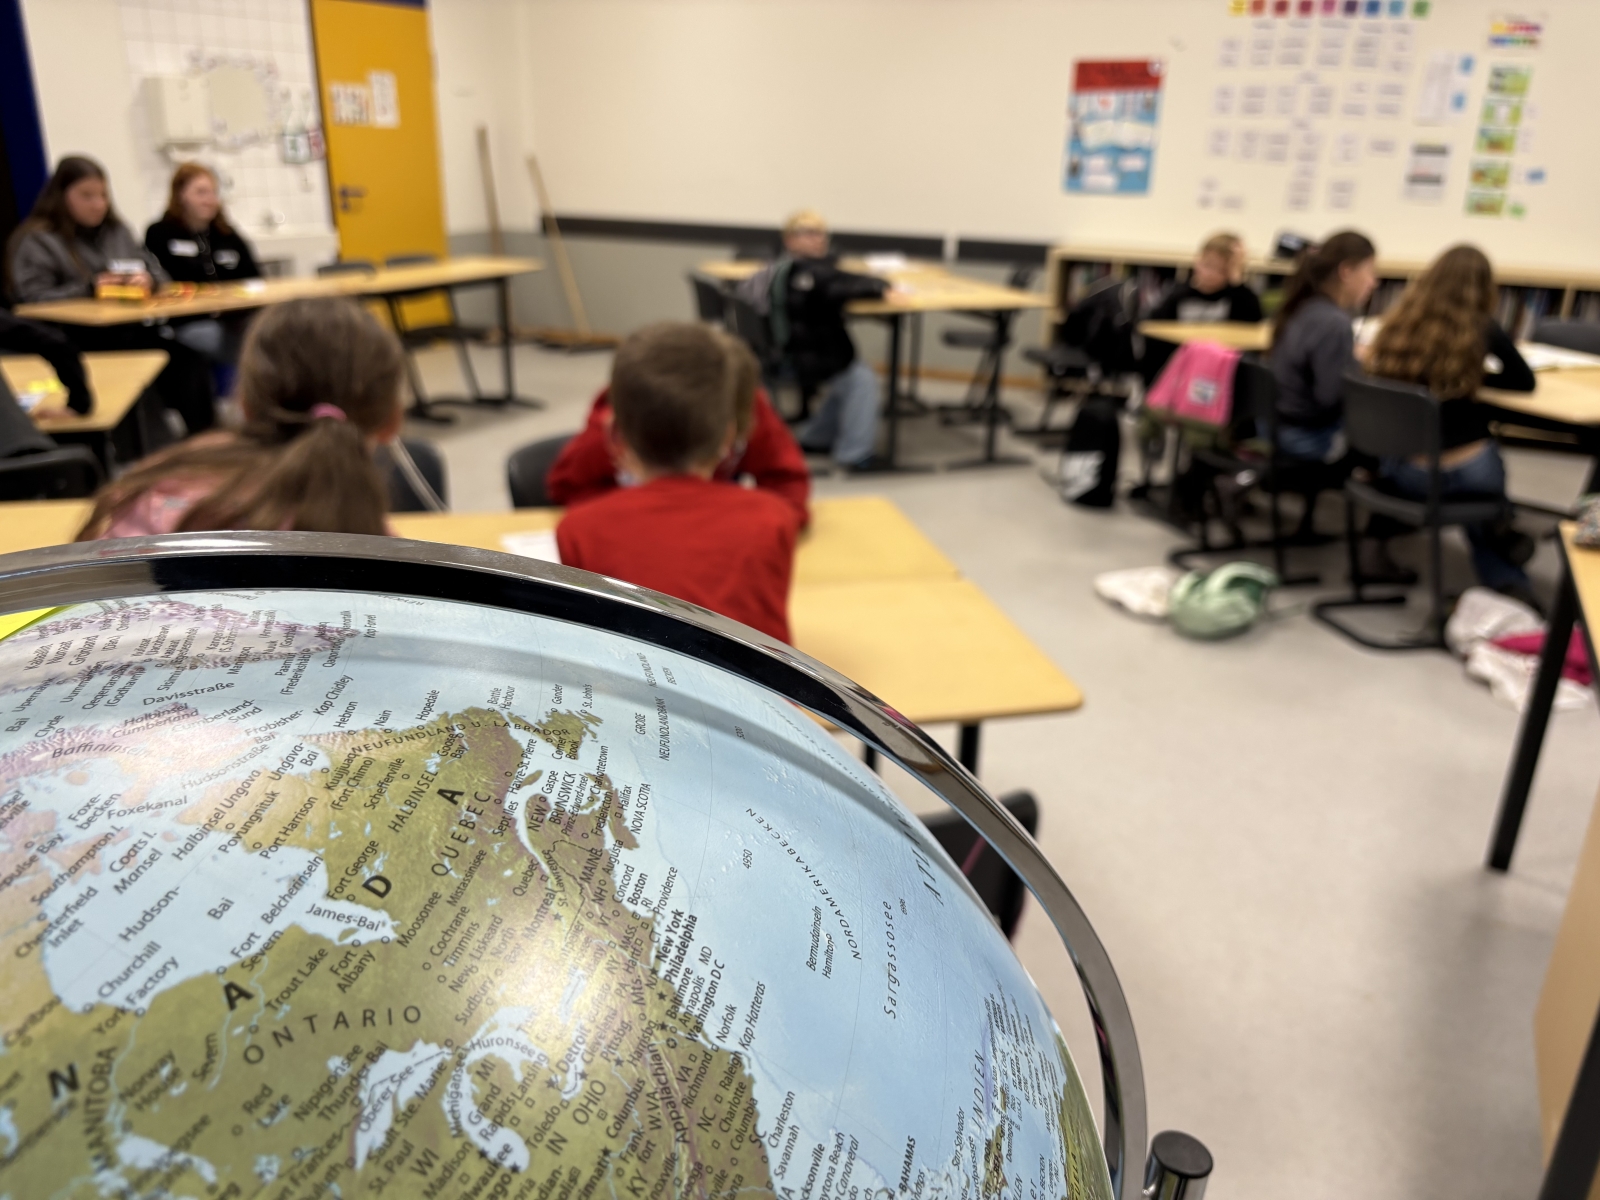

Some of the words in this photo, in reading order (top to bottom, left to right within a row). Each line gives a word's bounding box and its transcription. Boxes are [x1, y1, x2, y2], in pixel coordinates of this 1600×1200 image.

[274, 652, 297, 677] Paamiut
[142, 682, 235, 706] Davisstraße
[228, 705, 263, 724] Sund
[313, 698, 335, 716] Kap
[325, 674, 354, 702] Chidley
[333, 701, 359, 729] Hebron
[415, 689, 441, 722] Hopedale
[551, 683, 563, 705] Gander
[5, 717, 31, 733] Bai
[34, 714, 65, 738] Clyde
[112, 708, 199, 739] Cumberland
[244, 709, 304, 737] Frobisher-
[349, 723, 468, 756] NEUFUNDLAND
[493, 720, 572, 737] LABRADOR
[372, 708, 393, 727] Nain
[655, 695, 671, 762] NEUFUNDLANDBANK
[181, 743, 271, 791] Hudsonstraße
[266, 742, 306, 782] Ungava-
[299, 750, 321, 768] Bai
[436, 732, 460, 758] Goose
[450, 743, 470, 760] Bay
[551, 736, 568, 761] Corner
[565, 739, 580, 761] Brook
[322, 750, 360, 792] Kuujjuaq
[347, 756, 377, 790] Chimo)
[363, 757, 406, 810] Schefferville
[589, 745, 610, 795] Charlottetown
[67, 793, 103, 822] Foxe-
[75, 793, 122, 831] becken
[107, 795, 188, 819] Foxekanal
[171, 800, 230, 861] Halbinsel
[220, 769, 262, 809] Ungava
[386, 769, 439, 833] HALBINSEL
[527, 803, 549, 833] NEW
[548, 770, 577, 826] BRUNSWICK
[560, 773, 589, 838] Prinz-Edward-Insel
[590, 791, 614, 837] Fredericton
[619, 784, 633, 812] Halifax
[637, 782, 652, 812] SCOTIA
[218, 789, 281, 854] Povungnituk
[258, 836, 287, 860] Port
[278, 796, 320, 838] Harrison
[430, 791, 491, 877] QUEBEC
[30, 831, 116, 907] Southampton
[108, 838, 150, 874] Coats
[112, 847, 164, 896] Mansel
[326, 873, 352, 901] Fort
[344, 839, 380, 877] George
[512, 858, 540, 897] Quebec
[579, 847, 603, 885] MAINE
[601, 839, 624, 876] Augusta
[260, 855, 325, 925] Belcherinseln
[446, 849, 488, 908] Mistassinisee
[591, 886, 609, 907] NH
[611, 863, 636, 904] Concord
[626, 872, 649, 906] Boston
[652, 865, 679, 916] Providence
[14, 885, 100, 959] Chesterfield
[118, 885, 181, 943] Hudson-
[206, 897, 236, 920] Bai
[305, 903, 382, 932] James-Bai
[396, 890, 443, 949] Moosonee
[429, 904, 471, 957] Cochrane
[520, 887, 558, 942] Montreal
[664, 908, 685, 936] York
[47, 917, 86, 949] Inlet
[230, 931, 262, 959] Fort
[239, 929, 285, 973] Severn
[442, 920, 481, 968] Timmins
[448, 963, 475, 993] New
[468, 914, 504, 962] Liskeard
[489, 924, 517, 959] North
[655, 935, 675, 964] New
[663, 913, 698, 985] Philadelphia
[805, 905, 822, 972] Bermudainseln
[97, 940, 163, 999] Churchill
[329, 950, 359, 976] Fort
[336, 949, 377, 994] Albany
[698, 945, 713, 966] MD
[821, 937, 835, 980] Hamilton
[882, 900, 900, 1020] Sargassosee
[124, 955, 180, 1006] Factory
[264, 976, 304, 1012] Trout
[297, 946, 329, 978] Lake
[454, 975, 496, 1027] Sudbury
[630, 974, 647, 1007] Mts.
[665, 966, 694, 1020] Baltimore
[678, 974, 706, 1028] Annapolis
[685, 978, 721, 1043] Washington
[715, 1003, 738, 1044] Norfolk
[744, 981, 767, 1029] Hatteras
[242, 1005, 422, 1065] ONTARIO
[468, 1035, 537, 1059] Huronsee
[555, 1025, 592, 1075] Detroit
[580, 1005, 618, 1065] Cleveland
[600, 1019, 633, 1064] Pittsbg.
[627, 1019, 660, 1068] Harrisbg.
[737, 1026, 757, 1052] Kap
[293, 1043, 364, 1122] Nipigonsee
[316, 1061, 371, 1122] Thunder
[365, 1039, 390, 1065] Bai
[475, 1058, 497, 1082] MI
[510, 1051, 550, 1101] Lansing
[676, 1064, 694, 1084] VA
[680, 1050, 714, 1110] Richmond
[718, 1050, 743, 1091] Raleigh
[241, 1082, 274, 1115] Red
[358, 1084, 396, 1134] Oberer
[389, 1063, 416, 1090] See
[467, 1081, 502, 1126] Grand
[572, 1079, 607, 1126] OHIO
[605, 1076, 647, 1139] Columbus
[646, 1042, 691, 1144] Appalachian
[718, 1081, 748, 1133] Charlotte
[478, 1096, 516, 1141] Rapids
[525, 1104, 562, 1150] Toledo
[696, 1106, 717, 1133] NC
[730, 1096, 759, 1151] Columbia
[748, 1123, 768, 1149] SC
[767, 1090, 796, 1149] Charleston
[410, 1147, 441, 1177] WI
[544, 1131, 569, 1157] IN
[637, 1139, 657, 1165] fort
[773, 1124, 800, 1181] Savannah
[828, 1131, 846, 1166] Beach
[834, 1133, 860, 1197] Canaveral
[898, 1134, 917, 1194] BAHAMAS
[422, 1141, 474, 1200] Madison
[625, 1167, 649, 1199] KY
